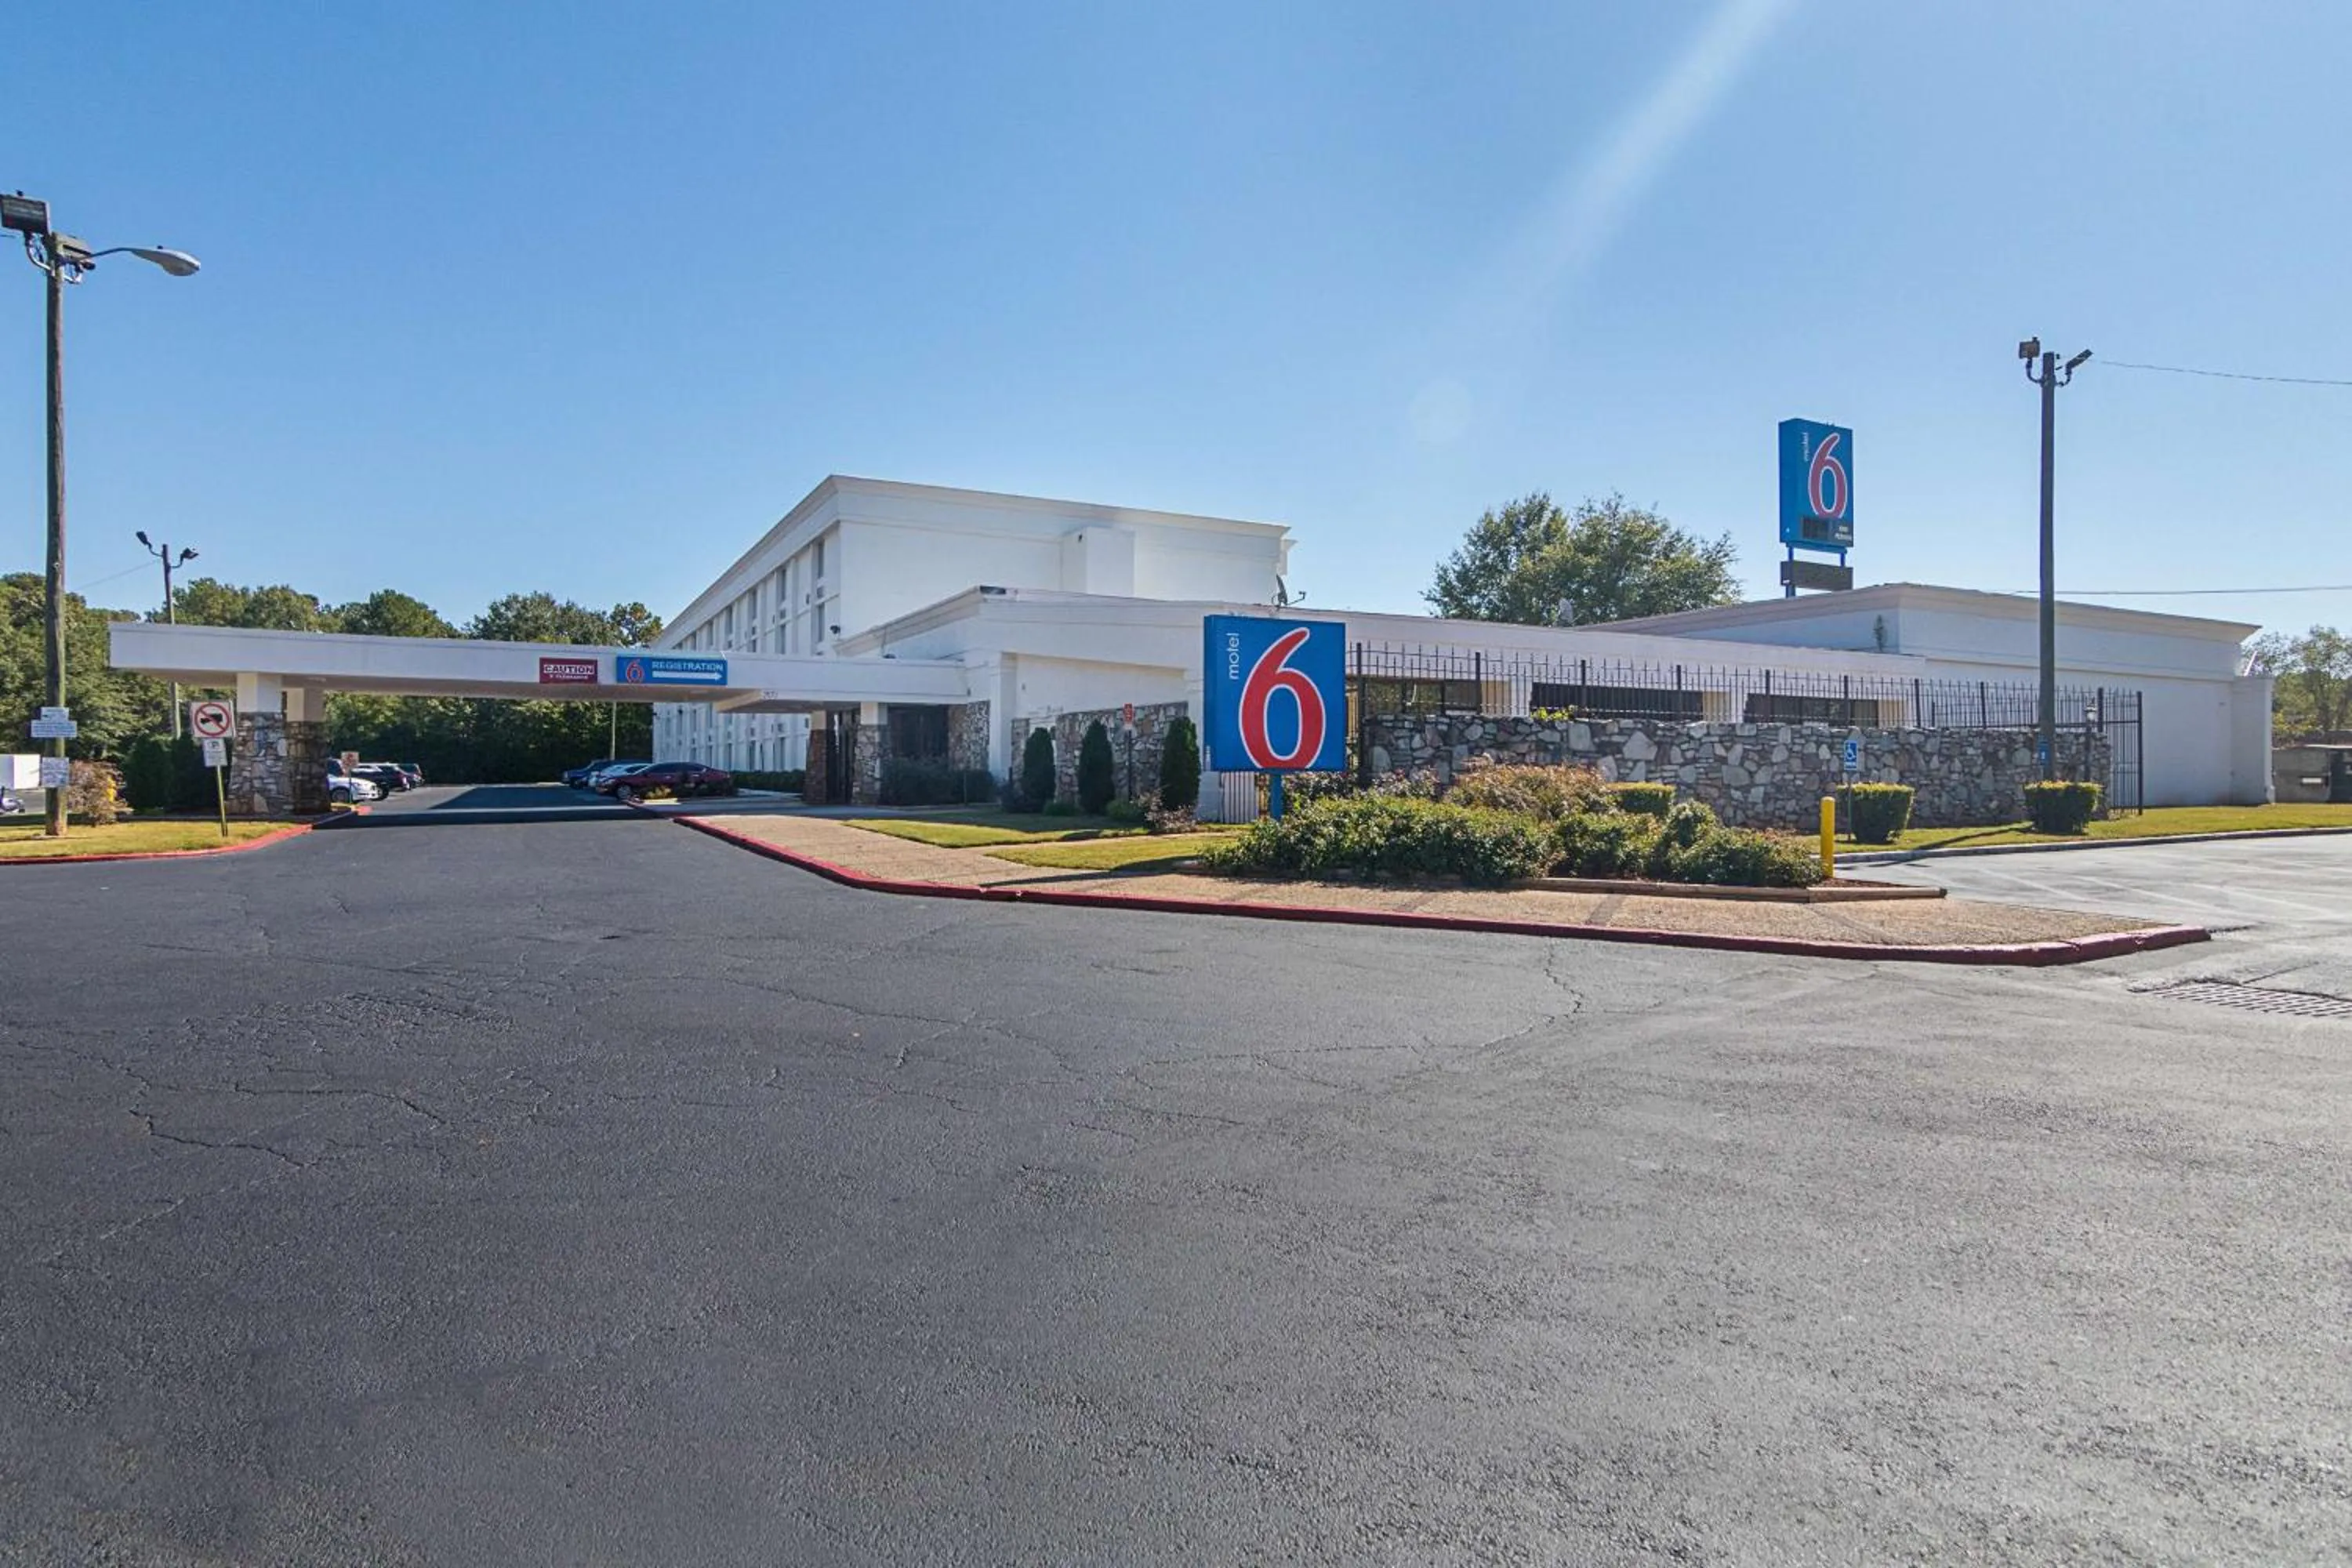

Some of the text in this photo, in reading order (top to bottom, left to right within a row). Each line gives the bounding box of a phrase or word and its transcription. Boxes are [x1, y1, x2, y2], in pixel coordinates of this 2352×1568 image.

[1808, 432, 1848, 518] 6
[543, 665, 594, 674] CAUTION
[626, 659, 644, 684] 6
[652, 661, 723, 672] REGISTRATION
[1226, 633, 1240, 680] motel
[1238, 627, 1326, 768] 6
